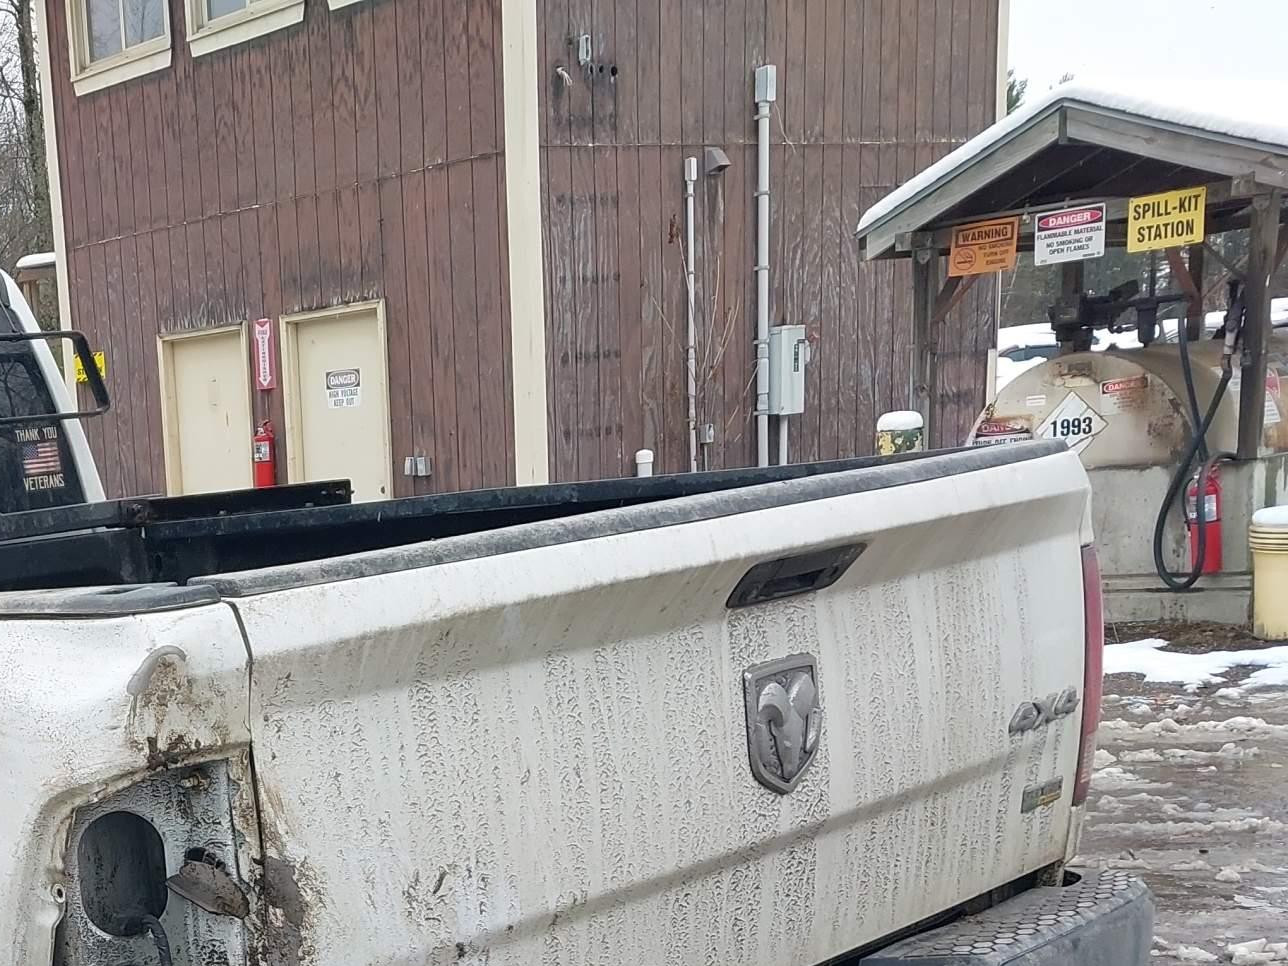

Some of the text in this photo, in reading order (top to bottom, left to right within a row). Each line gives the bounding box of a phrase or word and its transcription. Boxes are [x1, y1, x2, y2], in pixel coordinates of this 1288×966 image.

[1133, 193, 1201, 221] SPILL-KIT
[1048, 211, 1091, 227] DANGER
[961, 226, 1008, 243] WARNING
[1036, 225, 1104, 241] FLAMMABLE MATERIAL
[1136, 218, 1194, 243] STATION
[1046, 240, 1055, 248] NO
[1056, 236, 1083, 248] SMOKING
[1049, 243, 1090, 256] OPEN FLAMES
[330, 373, 356, 385] DANGER
[15, 426, 58, 442] THANK YOU
[1050, 416, 1093, 438] 1993
[23, 473, 65, 491] VETERANS
